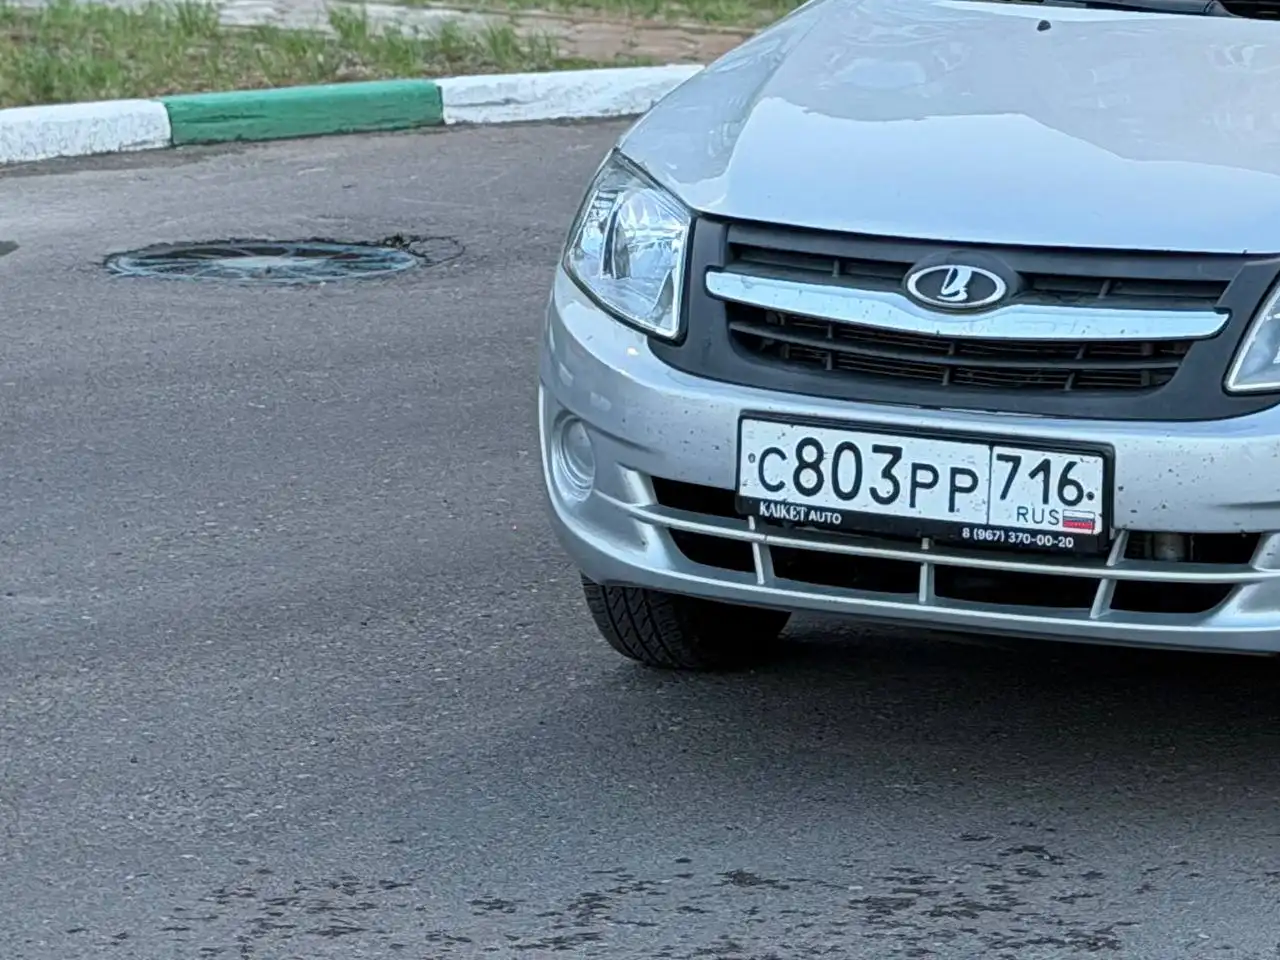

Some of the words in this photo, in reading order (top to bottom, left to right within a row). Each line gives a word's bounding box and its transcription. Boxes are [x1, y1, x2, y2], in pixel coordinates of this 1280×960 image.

[996, 454, 1084, 506] 716
[809, 511, 841, 524] AUTO
[1016, 506, 1059, 525] RUS
[962, 528, 970, 538] 8
[974, 529, 1004, 542] (967)
[1009, 532, 1073, 547] 370-00-20
